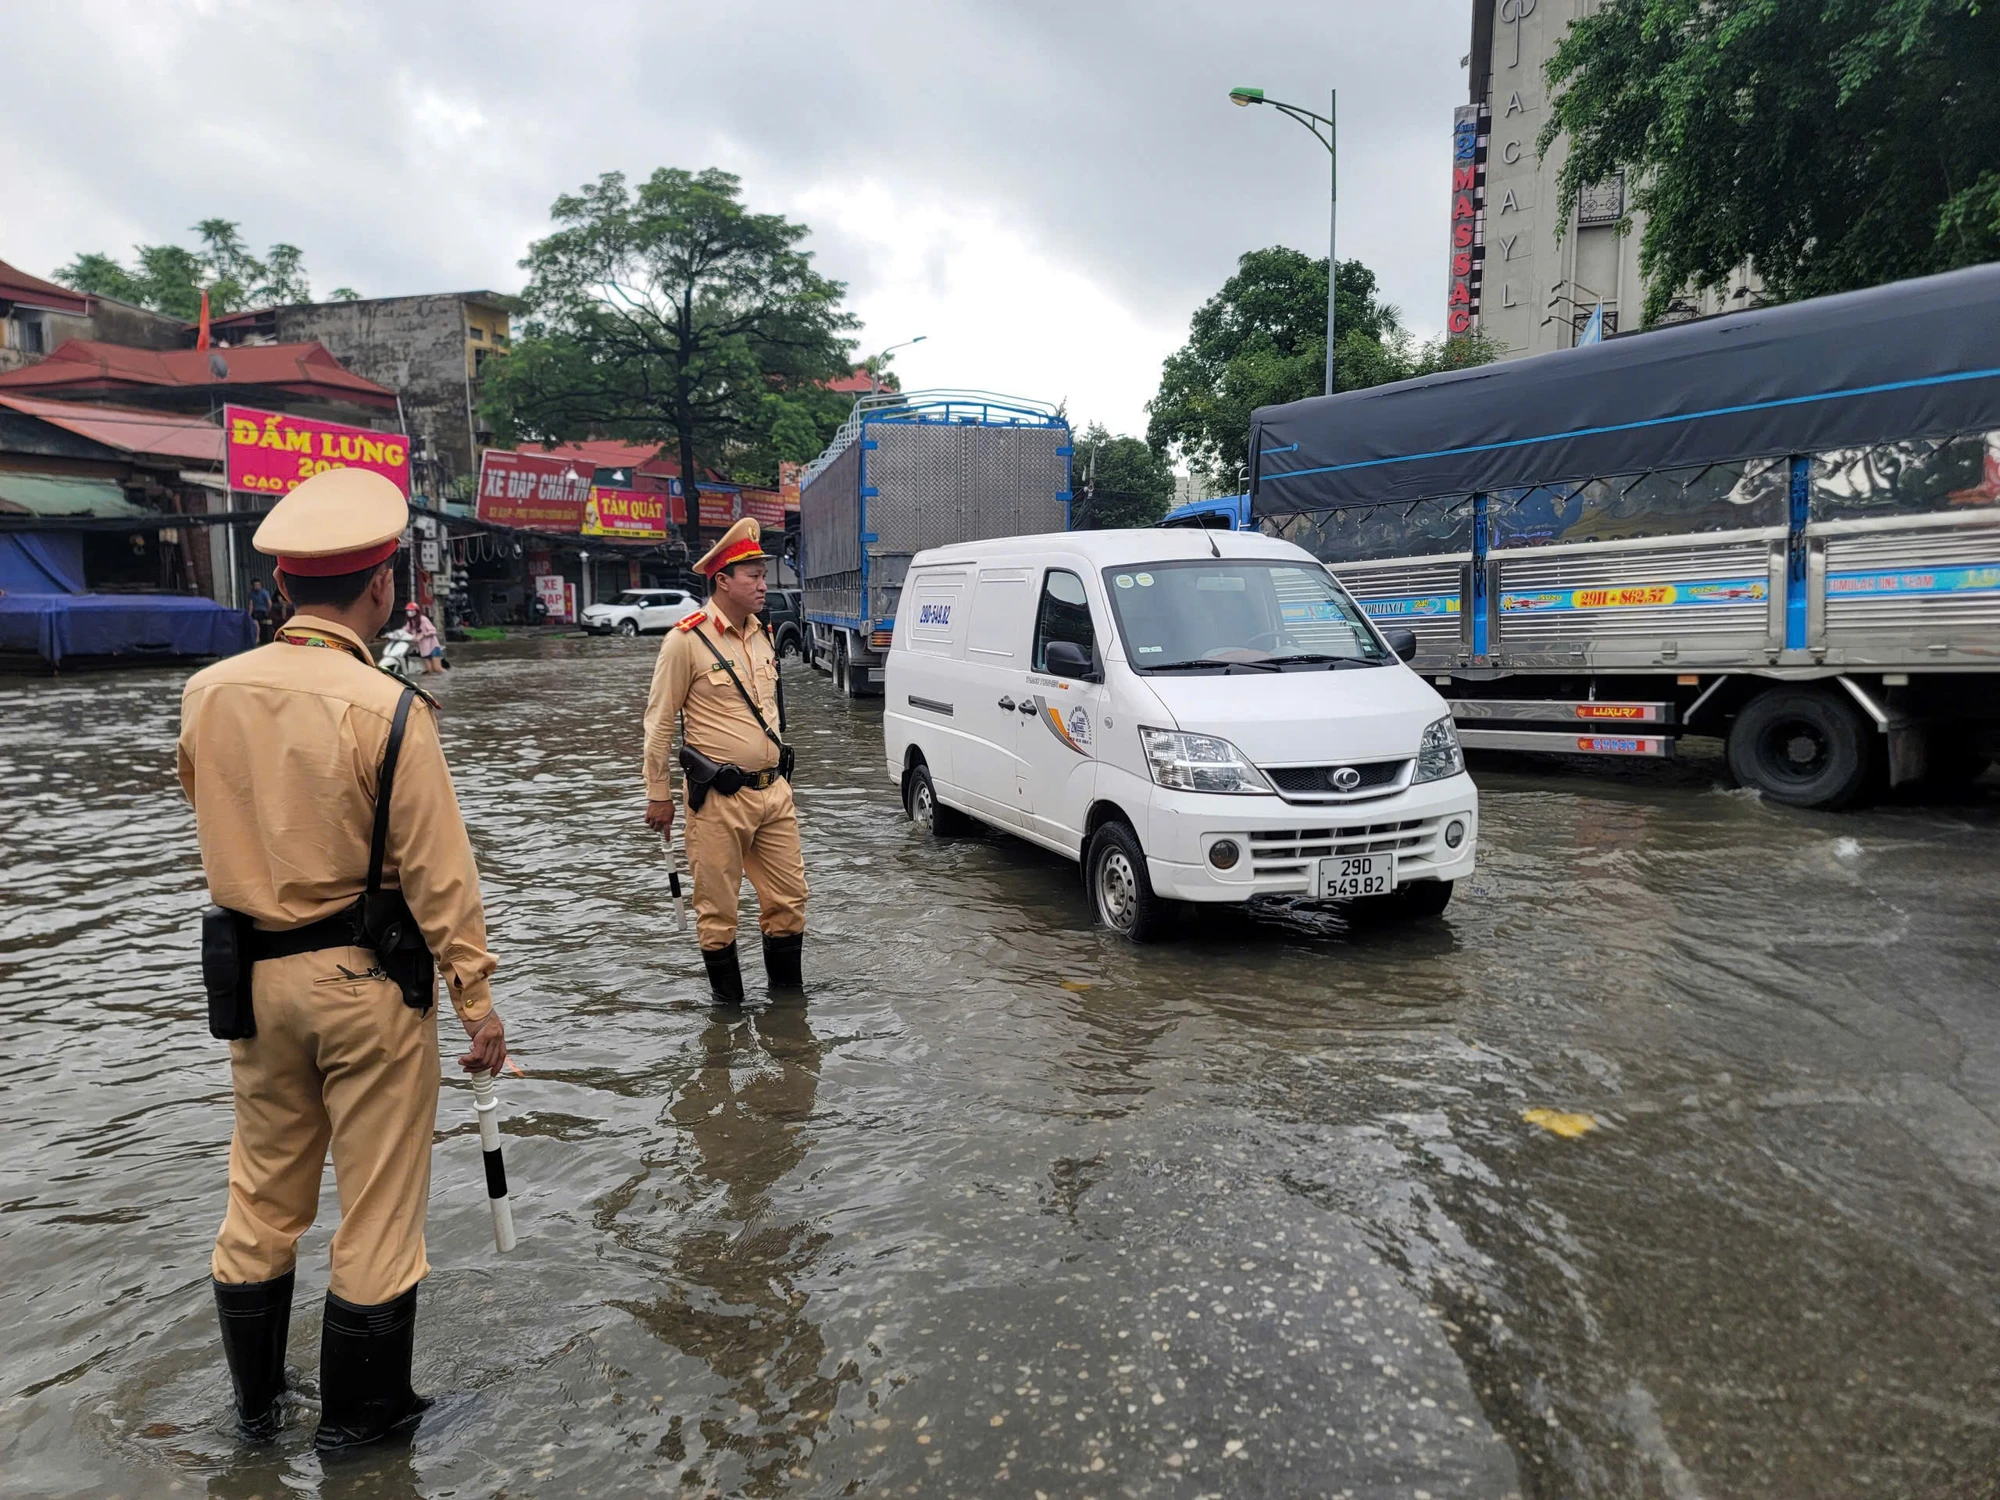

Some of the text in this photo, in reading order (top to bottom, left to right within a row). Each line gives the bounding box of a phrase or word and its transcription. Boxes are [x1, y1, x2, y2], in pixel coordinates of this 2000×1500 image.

[232, 415, 404, 467] ĐẤM LƯNG
[485, 469, 506, 498] XE
[543, 580, 557, 590] XE
[920, 605, 950, 624] 29D-549.82
[1593, 707, 1638, 718] LUXURY
[1341, 858, 1372, 877] 29D
[1327, 876, 1384, 897] 549.82
